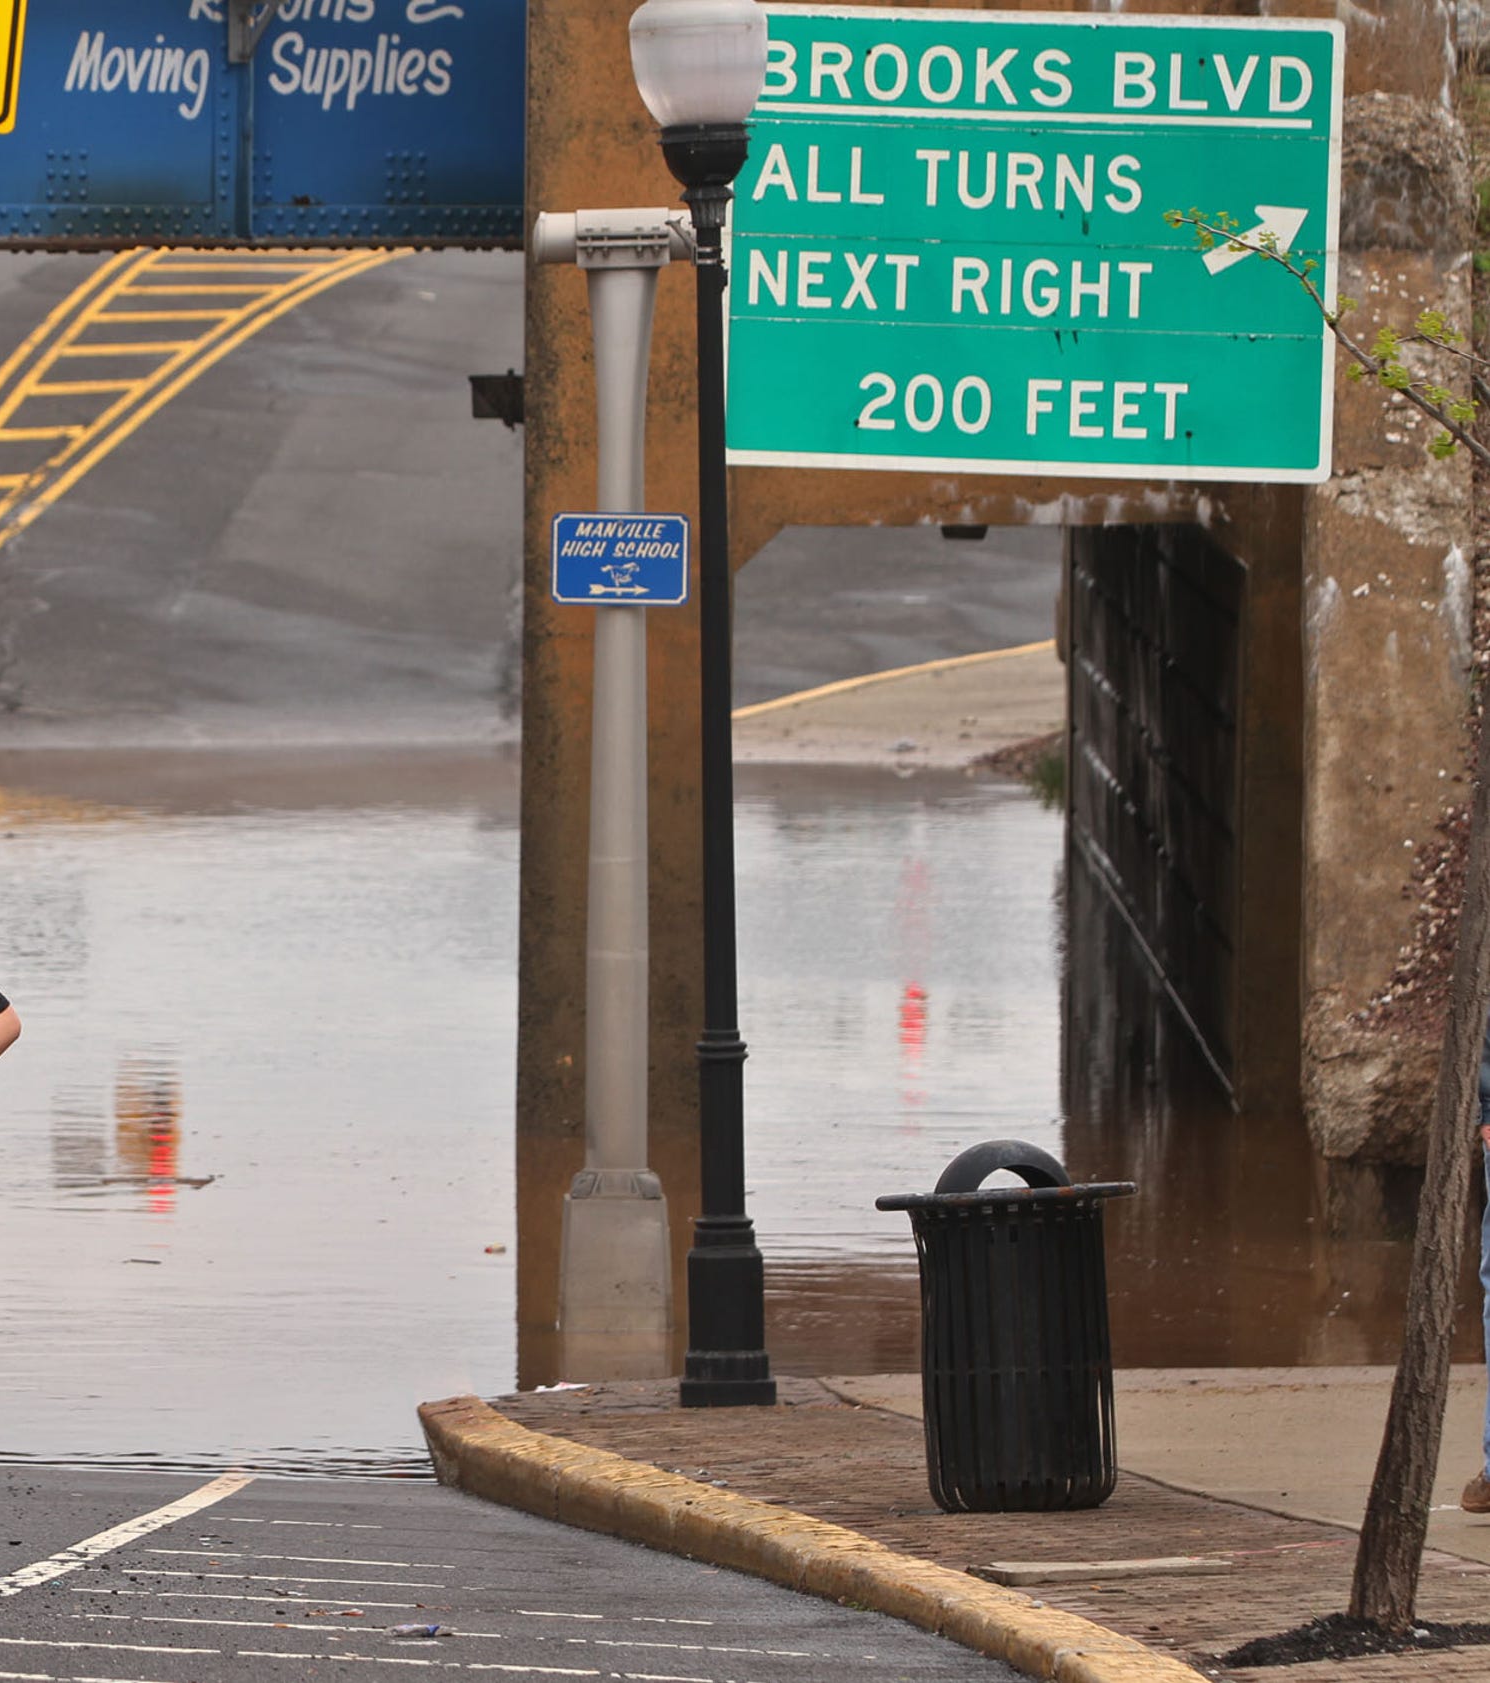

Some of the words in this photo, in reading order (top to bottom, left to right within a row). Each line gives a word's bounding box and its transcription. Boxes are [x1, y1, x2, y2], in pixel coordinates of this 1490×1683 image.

[64, 31, 211, 120] Moving
[268, 31, 454, 111] Supplies
[760, 40, 1073, 107] BROOKS
[1112, 51, 1313, 112] BLVD
[752, 143, 885, 205] ALL
[915, 149, 1143, 214] TURNS
[748, 249, 920, 311] NEXT
[951, 256, 1153, 319] RIGHT
[858, 371, 992, 434] 200
[1025, 378, 1189, 441] FEET
[560, 540, 607, 558] HIGH
[612, 541, 681, 559] SCHOOL
[575, 521, 666, 539] MANVILLE
